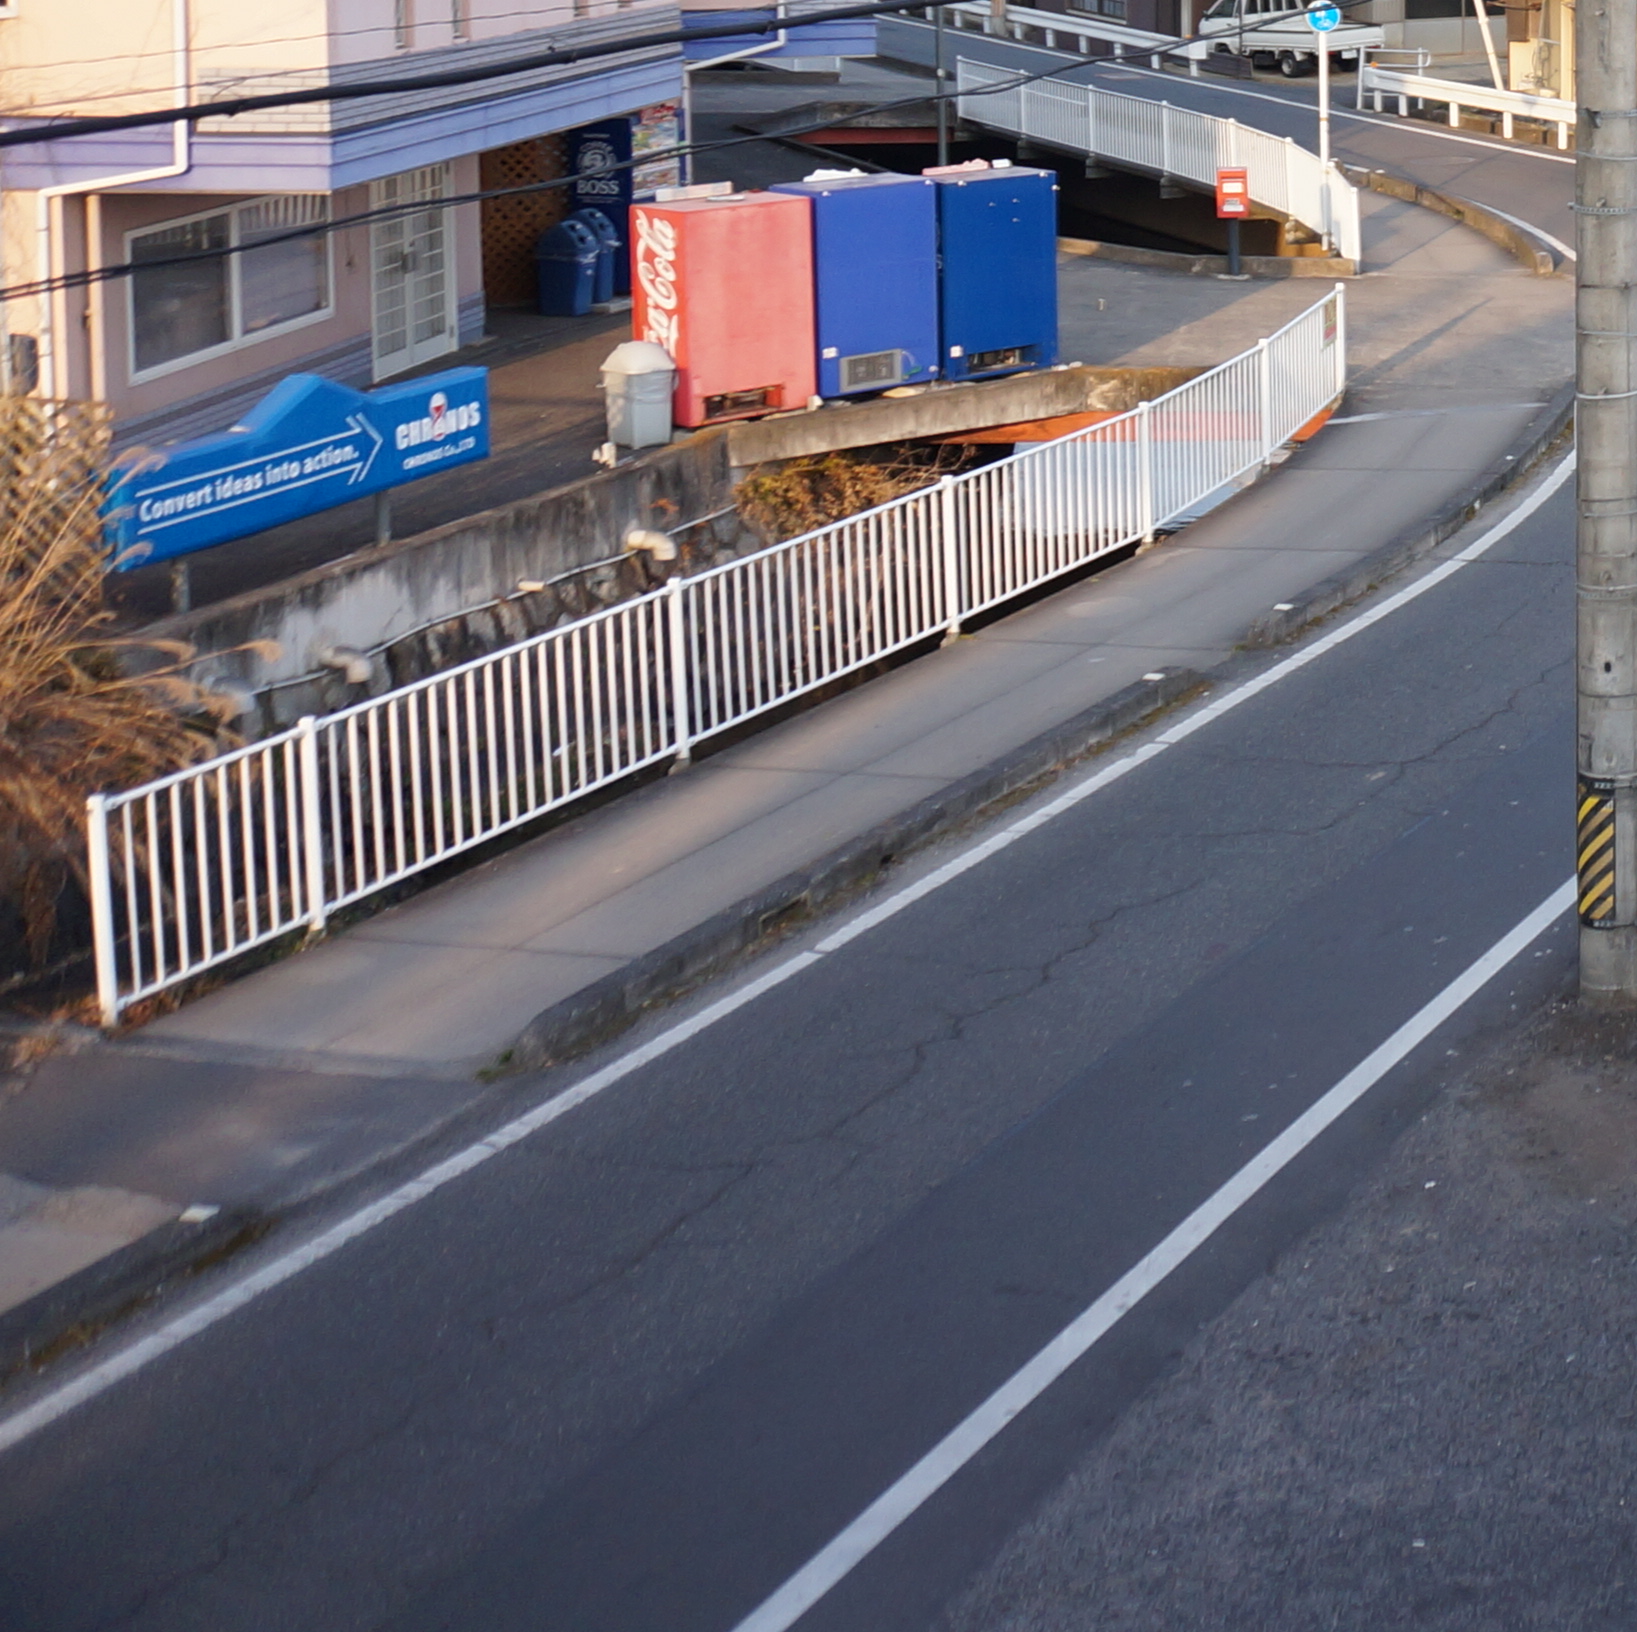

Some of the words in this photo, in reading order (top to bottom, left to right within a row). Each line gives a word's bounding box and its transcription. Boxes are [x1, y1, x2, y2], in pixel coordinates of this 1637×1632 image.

[577, 180, 620, 194] BOSS
[139, 481, 213, 523] Convert
[215, 472, 263, 501] ideas
[265, 461, 300, 487] into
[302, 444, 359, 475] action.
